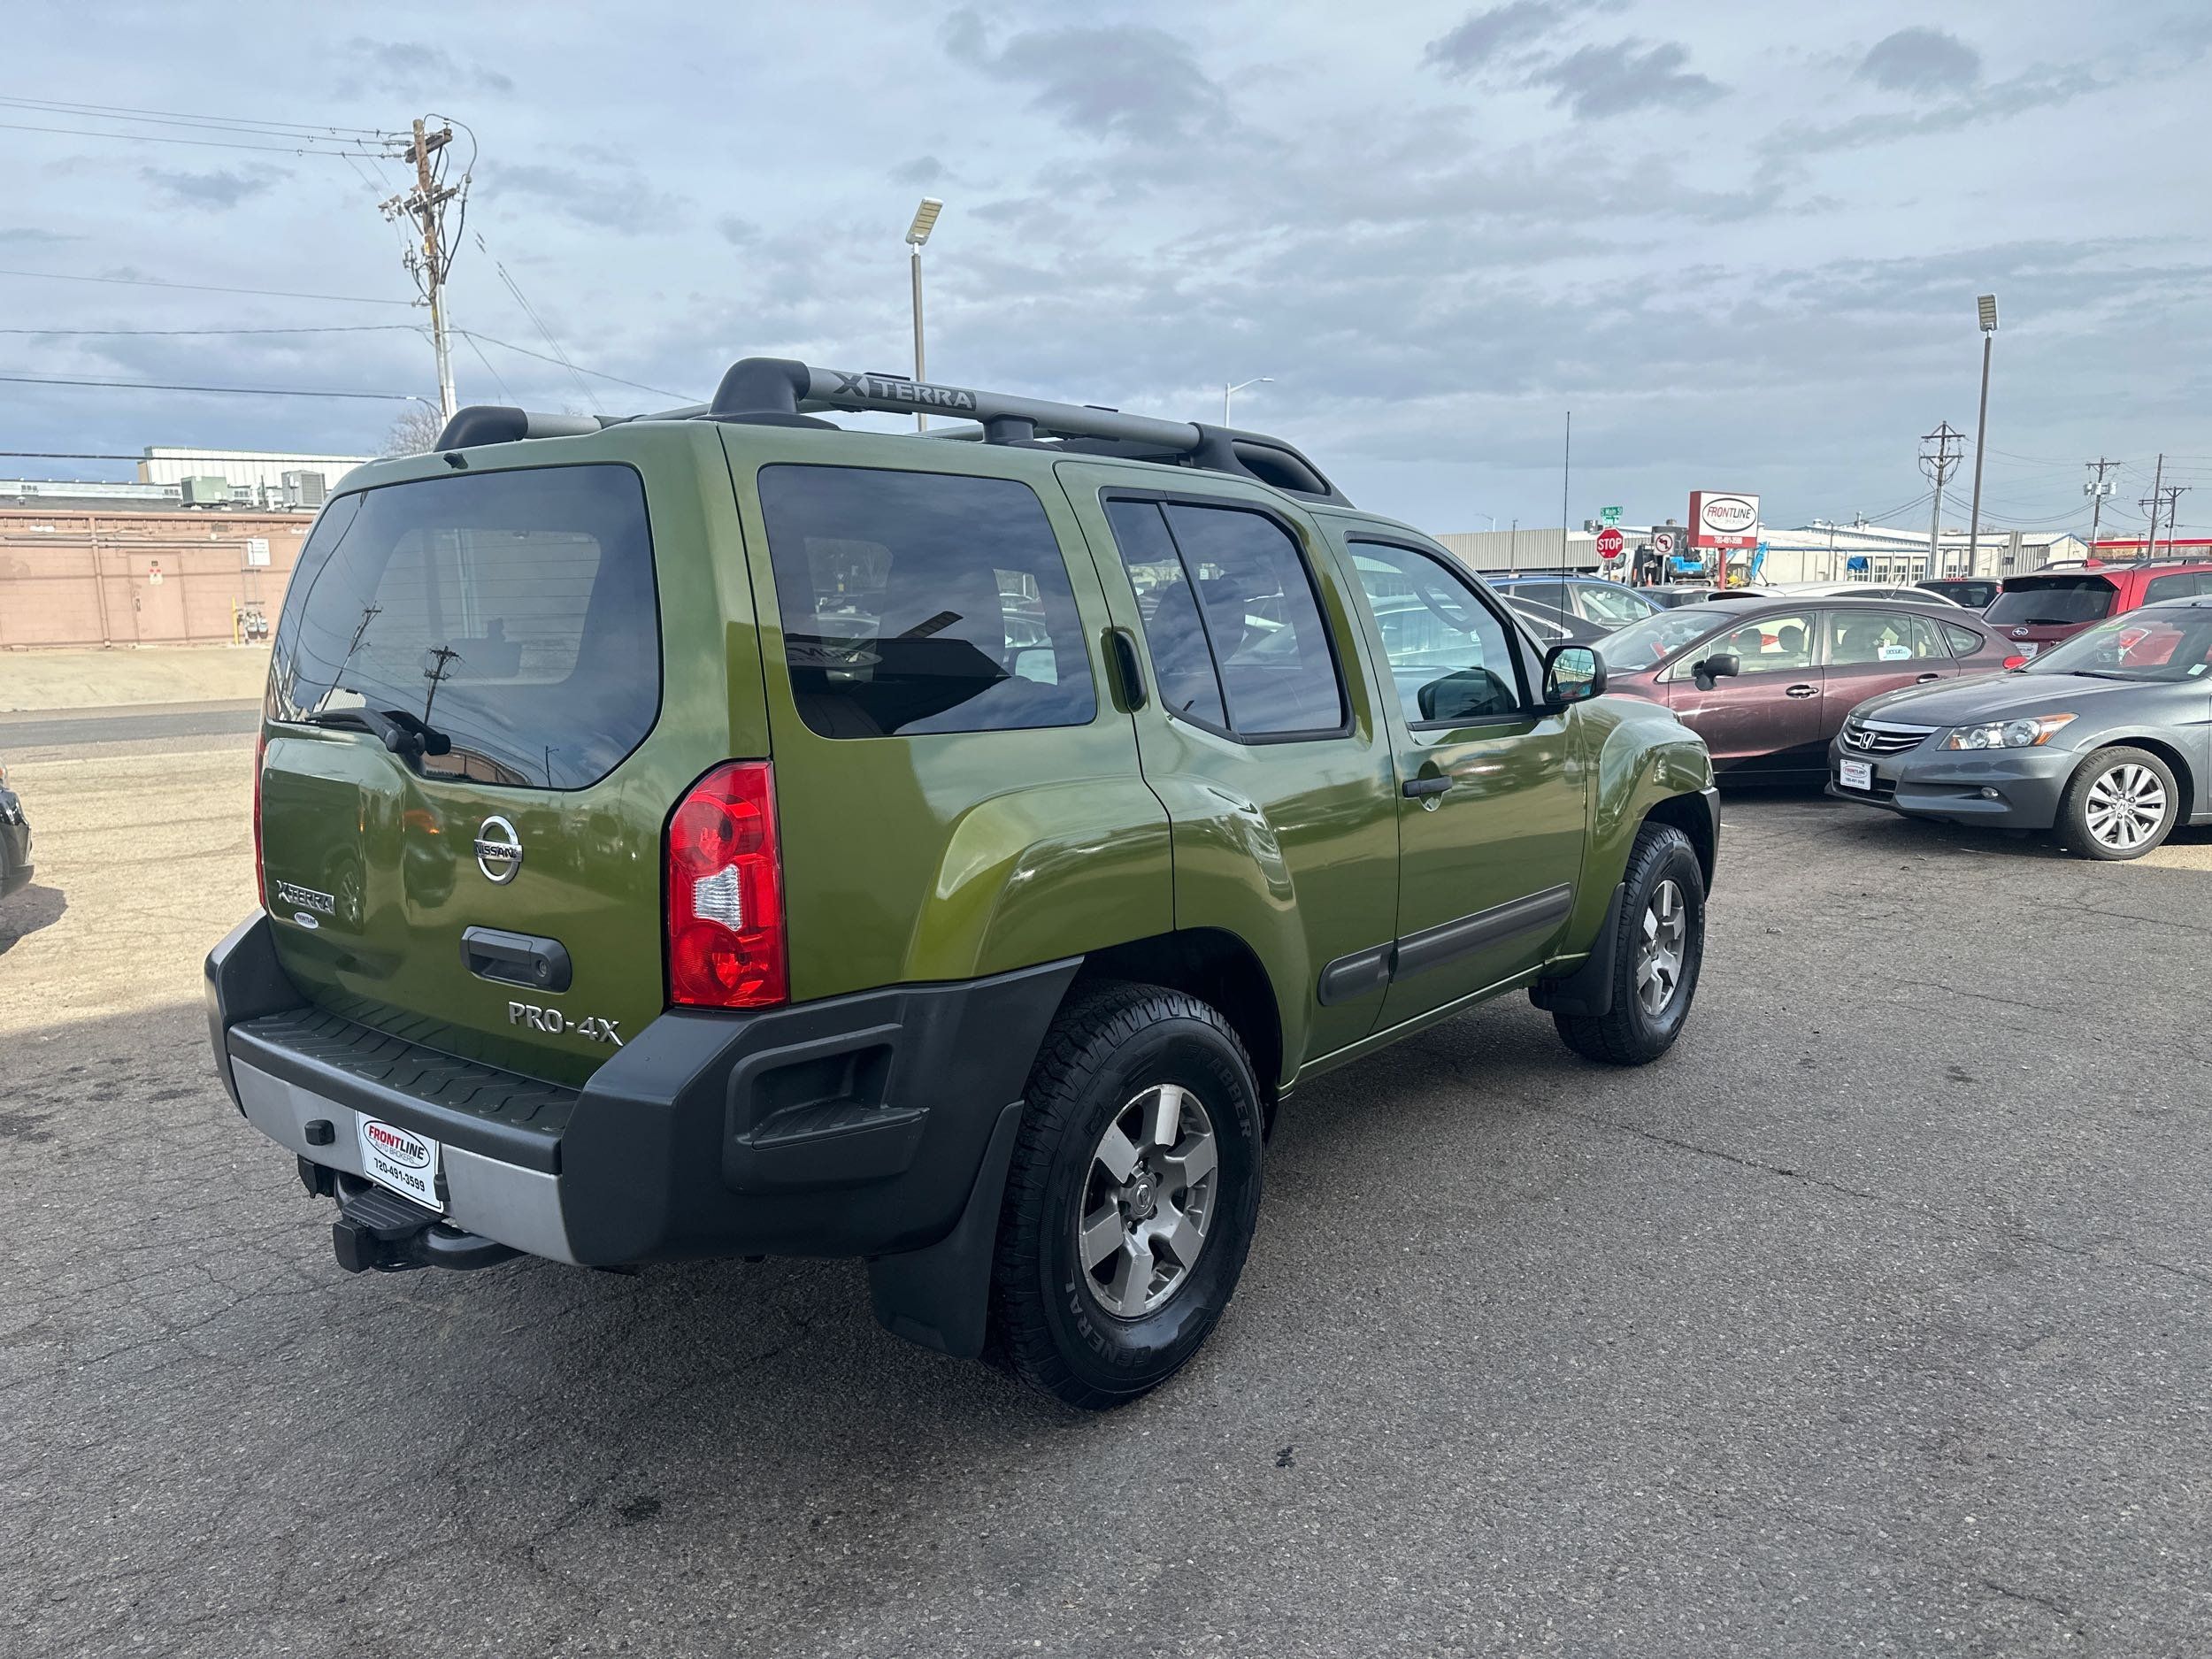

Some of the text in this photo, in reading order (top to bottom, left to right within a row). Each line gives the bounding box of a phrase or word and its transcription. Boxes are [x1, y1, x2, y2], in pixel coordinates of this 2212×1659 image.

[830, 371, 974, 411] XTERRA
[1707, 506, 1752, 519] FRONTLINE
[1598, 538, 1622, 550] STOP
[475, 841, 516, 859] NISSAN
[276, 879, 335, 916] XTERRA
[508, 1001, 624, 1046] PRO-4X
[368, 1125, 426, 1161] FRONTLINE
[374, 1140, 415, 1164] AUTO BROKERS
[373, 1156, 426, 1193] 720-491-3599
